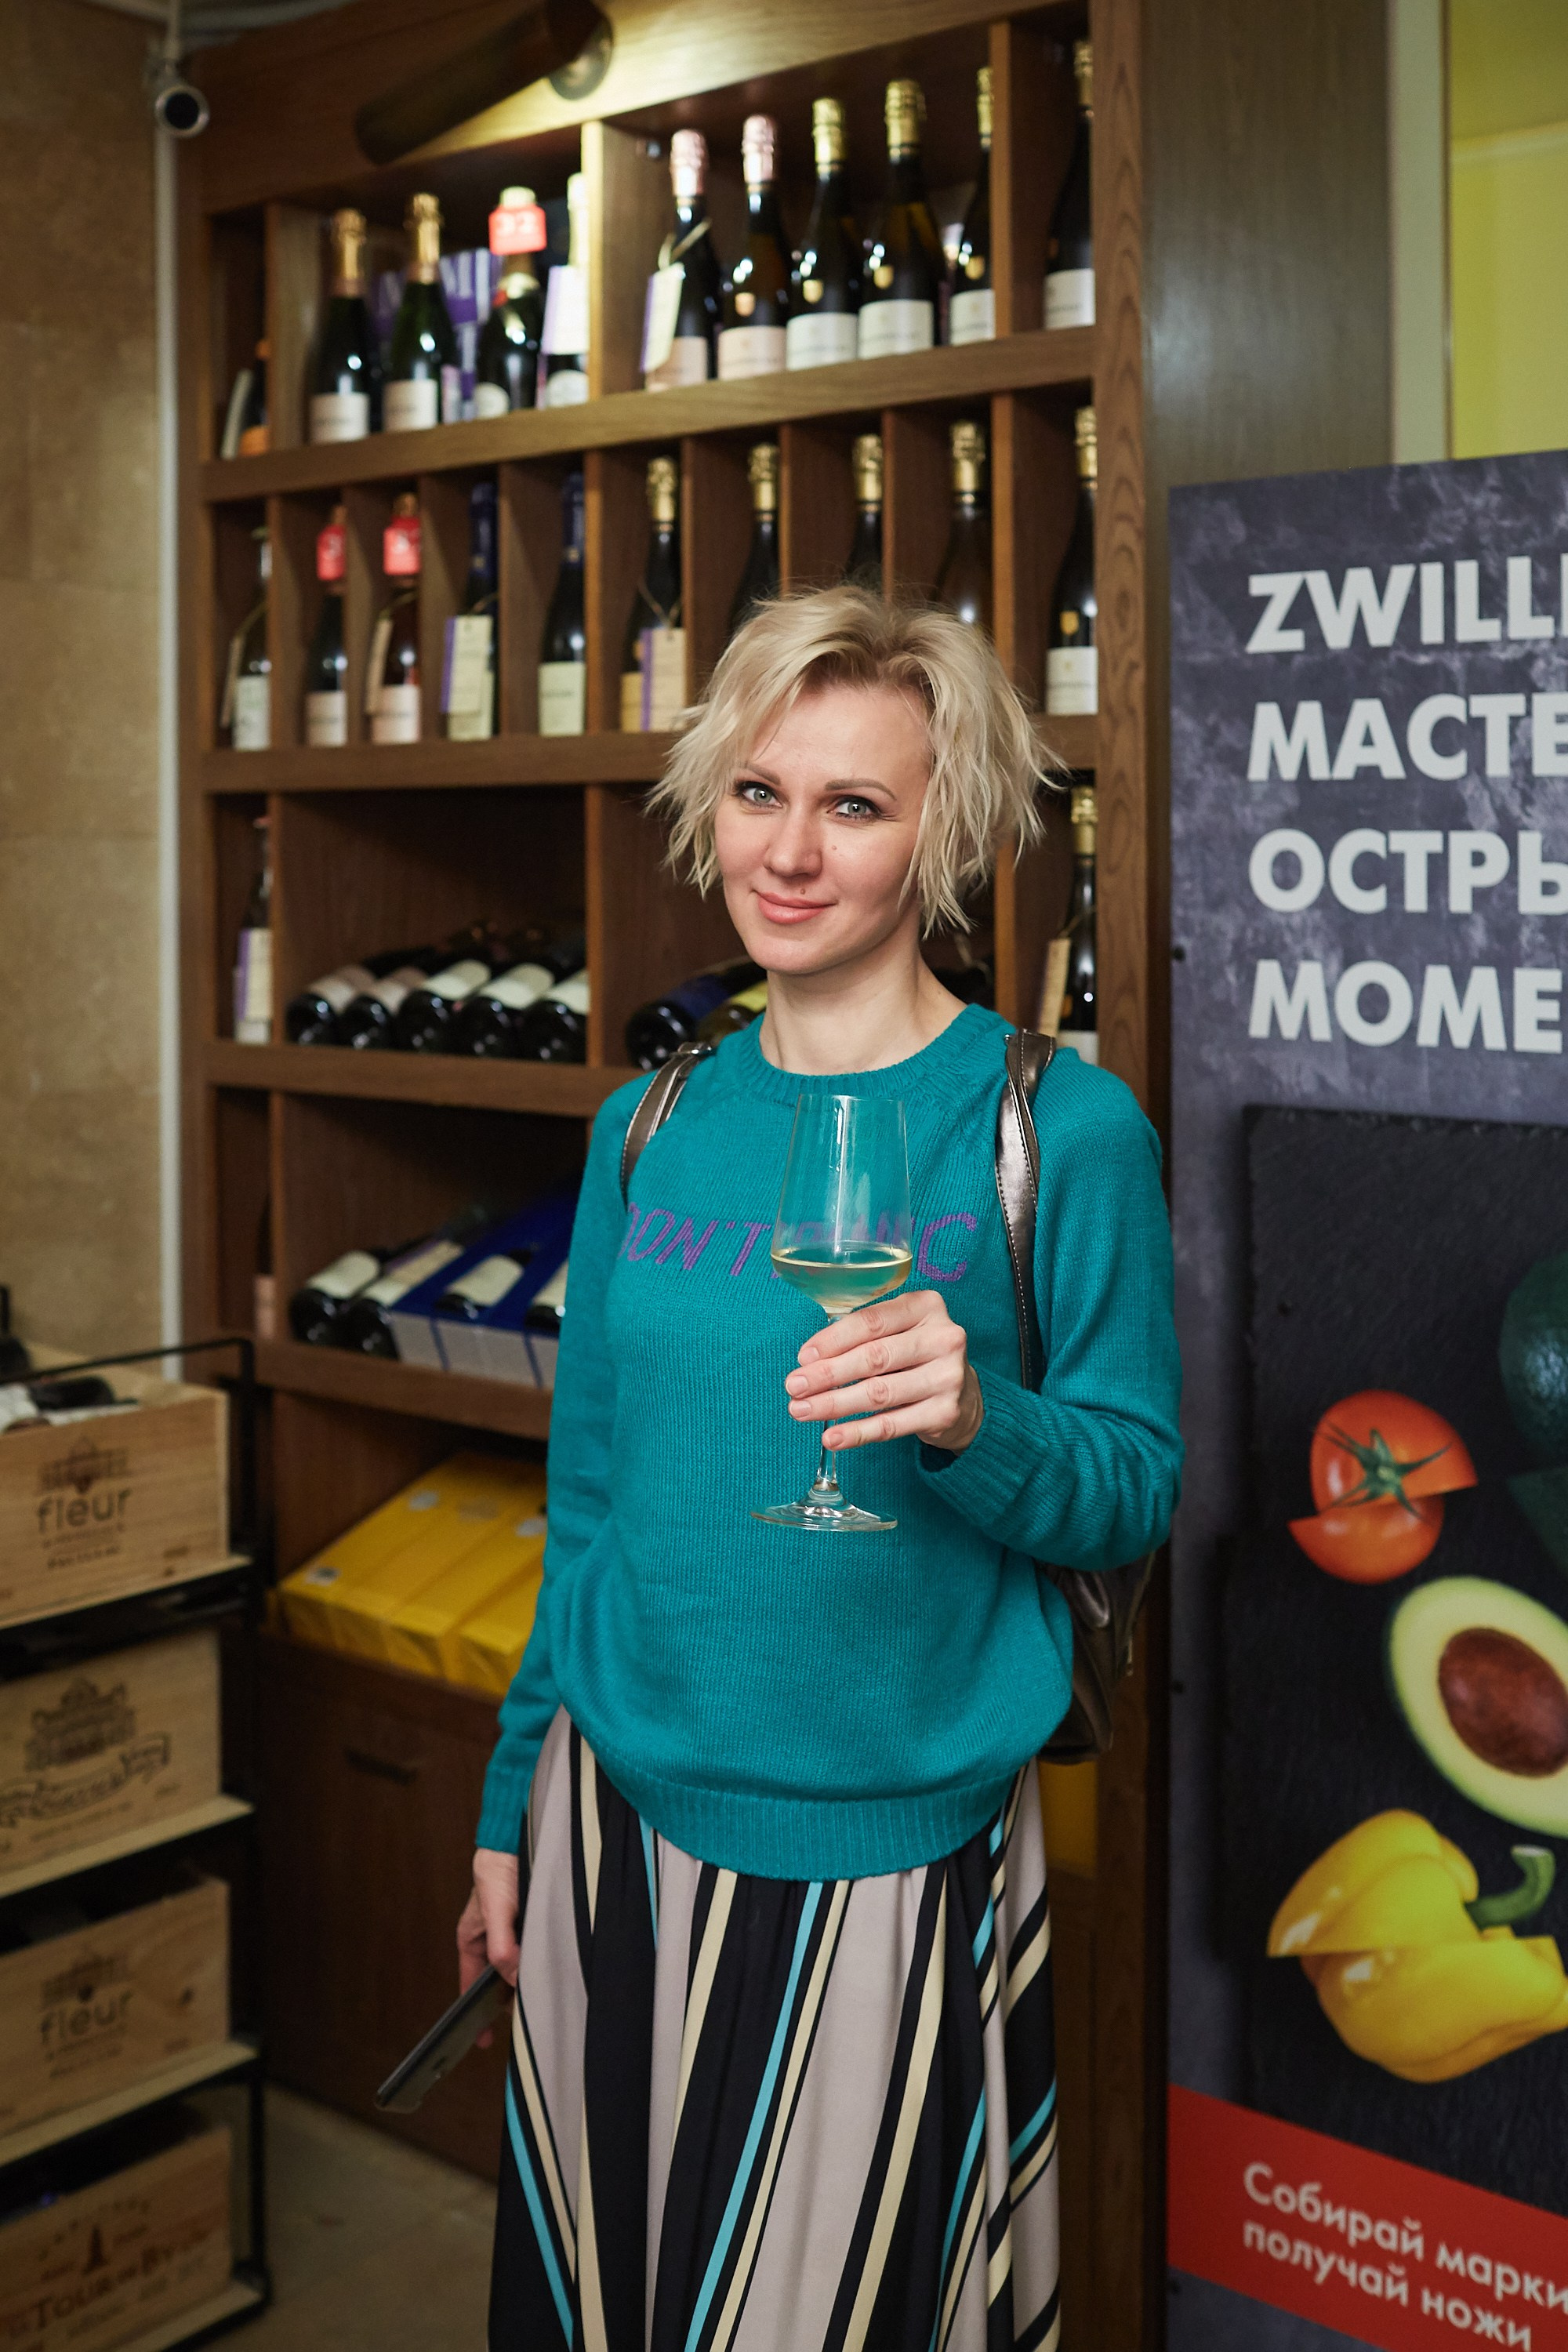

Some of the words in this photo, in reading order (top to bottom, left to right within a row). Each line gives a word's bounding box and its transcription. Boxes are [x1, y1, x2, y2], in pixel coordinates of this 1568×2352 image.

[1247, 692, 1568, 782] МАСТЕ
[1248, 959, 1563, 1054] МОМЕ
[37, 1487, 132, 1534] fleur
[1243, 2161, 1425, 2262] Собирай
[1435, 2241, 1568, 2315] марки
[1242, 2220, 1409, 2307] получай
[1420, 2286, 1533, 2352] ножи
